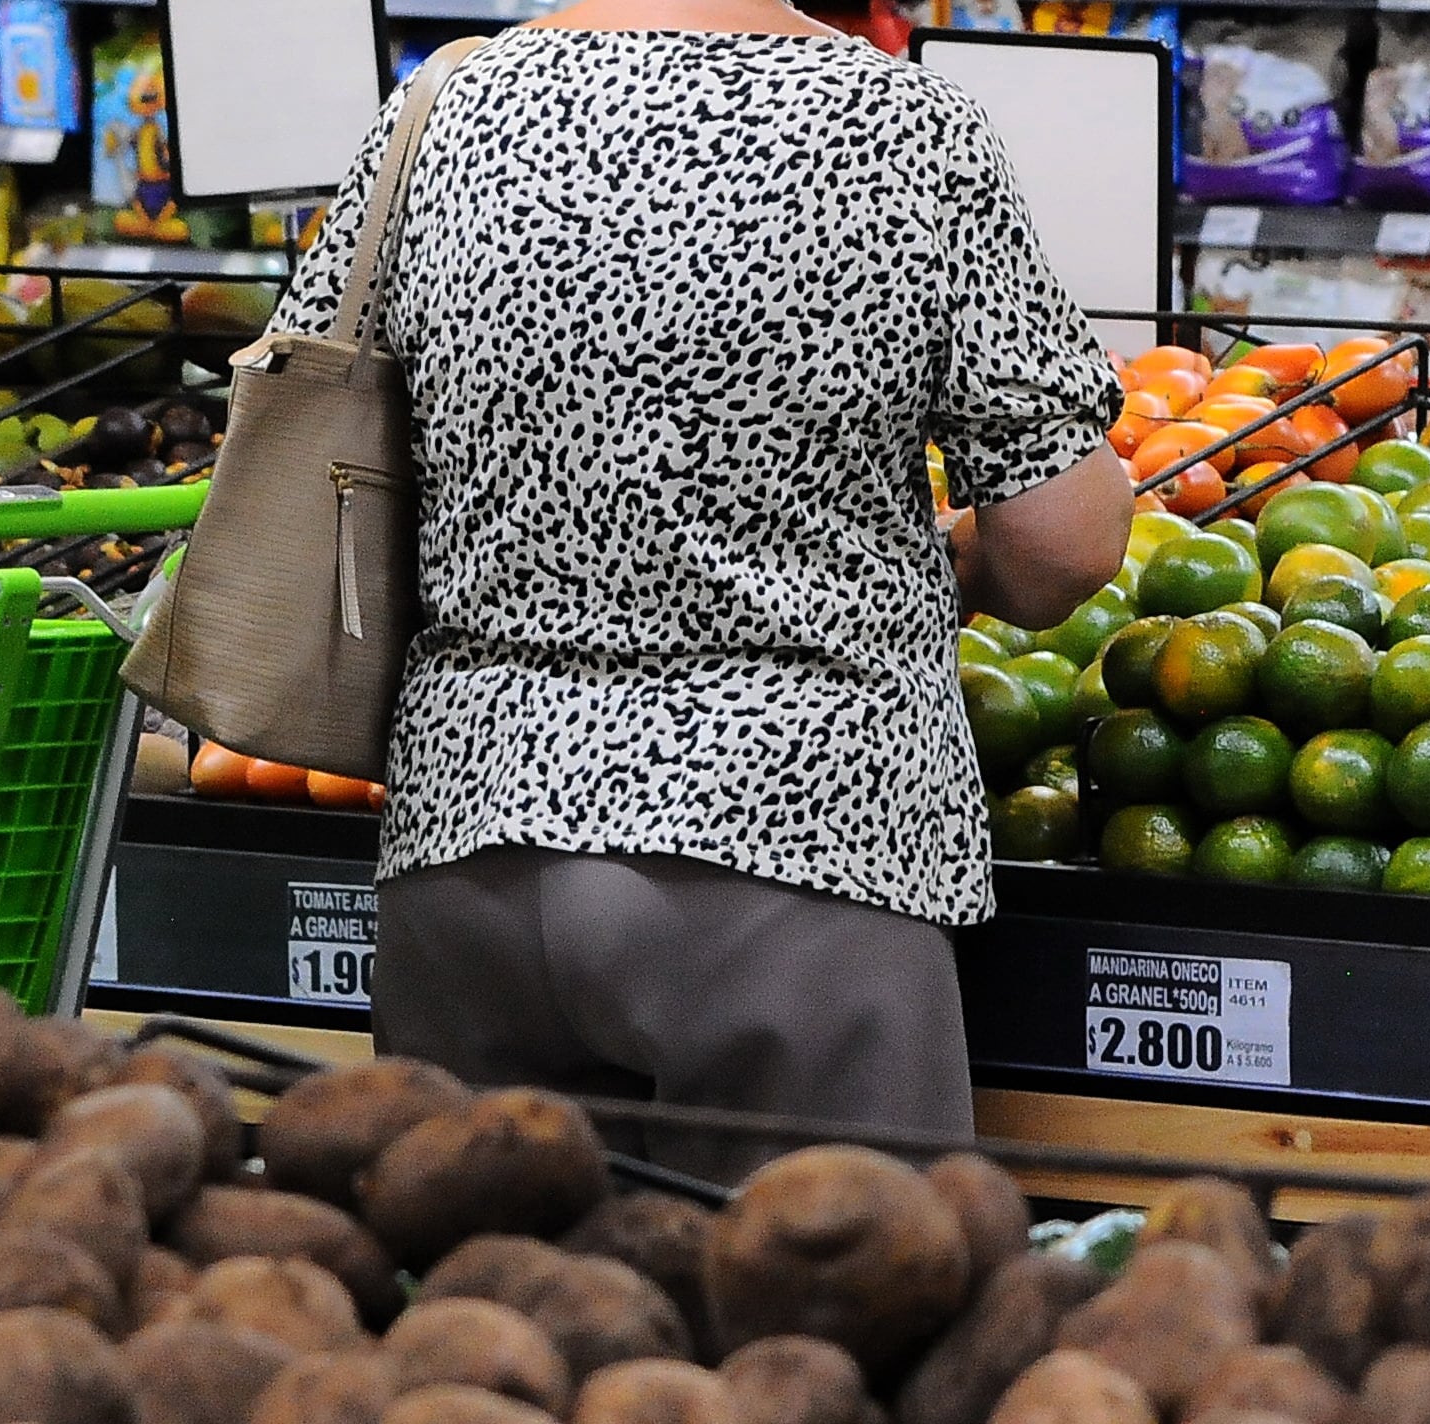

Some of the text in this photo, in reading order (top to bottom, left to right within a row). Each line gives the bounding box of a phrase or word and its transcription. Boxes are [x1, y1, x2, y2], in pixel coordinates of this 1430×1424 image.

[293, 889, 351, 912] TOMATE
[290, 916, 303, 937] A
[1090, 954, 1219, 984] MANDARINA ONECO
[1089, 982, 1102, 1004] A
[1228, 977, 1268, 992] ITEM
